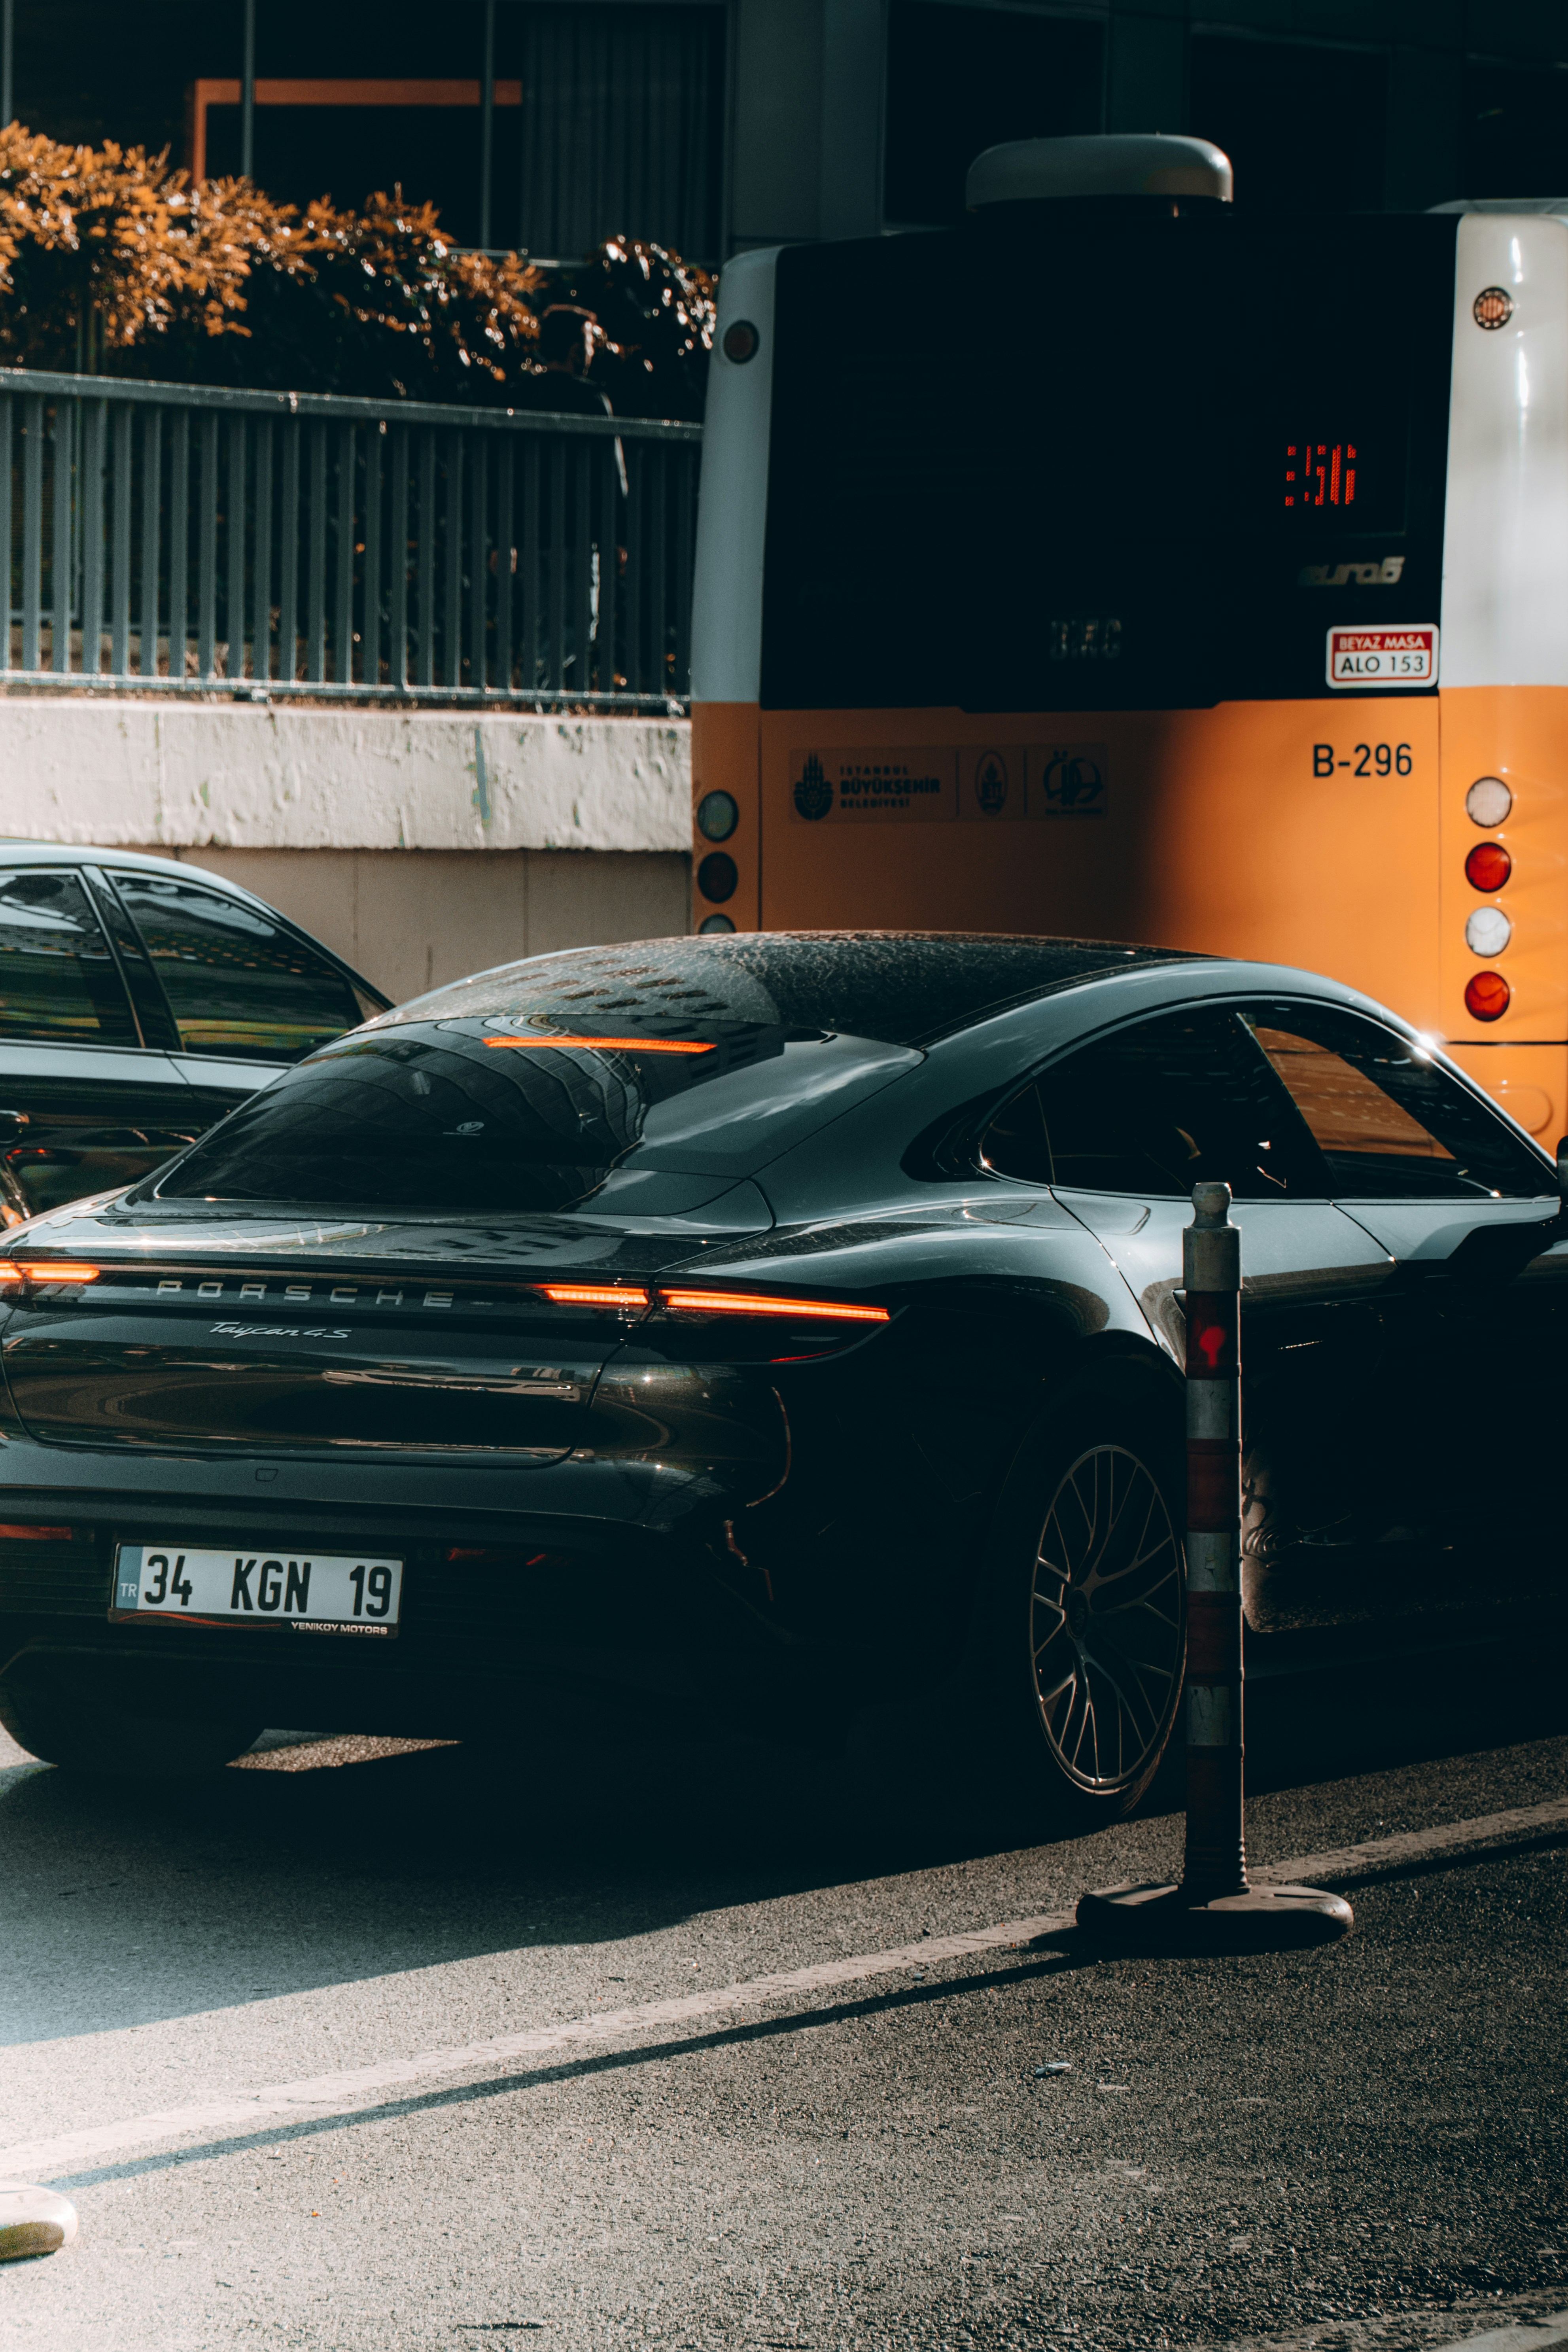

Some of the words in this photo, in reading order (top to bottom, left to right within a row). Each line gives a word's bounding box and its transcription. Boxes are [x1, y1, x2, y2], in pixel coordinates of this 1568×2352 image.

[1339, 636, 1381, 651] BEYAZ
[1384, 634, 1425, 649] MASA
[1341, 657, 1380, 674] ALO
[1390, 656, 1423, 672] 153
[1313, 743, 1412, 777] B-296
[157, 1280, 454, 1308] PORSCHE
[209, 1322, 299, 1338] Taycan
[120, 1583, 138, 1597] TR
[145, 1554, 193, 1606] 34
[230, 1558, 311, 1613] KGN
[349, 1565, 392, 1618] 19
[340, 1624, 388, 1635] MOTORS
